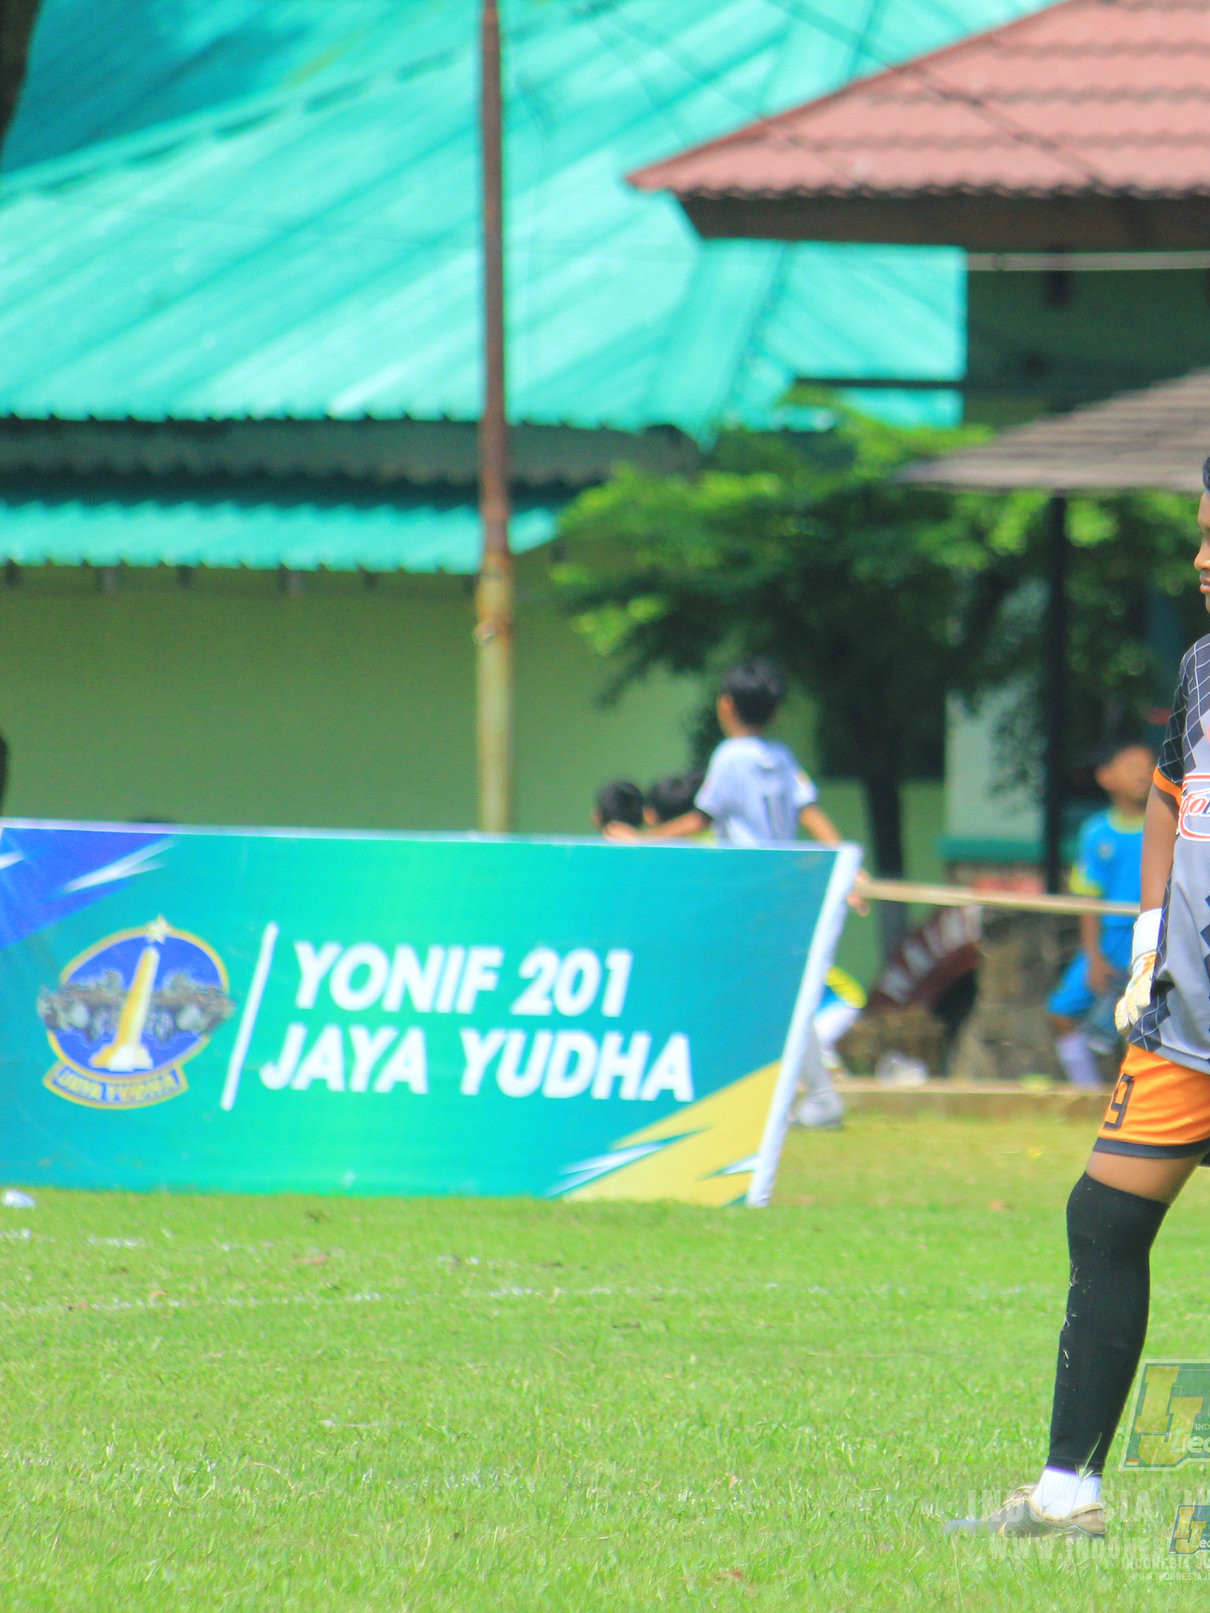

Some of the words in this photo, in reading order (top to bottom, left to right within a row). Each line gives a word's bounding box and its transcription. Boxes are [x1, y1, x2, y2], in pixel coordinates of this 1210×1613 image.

[294, 942, 504, 1014] YONIF
[509, 947, 633, 1017] 201
[259, 1022, 428, 1094] JAYA
[459, 1027, 694, 1102] YUDHA
